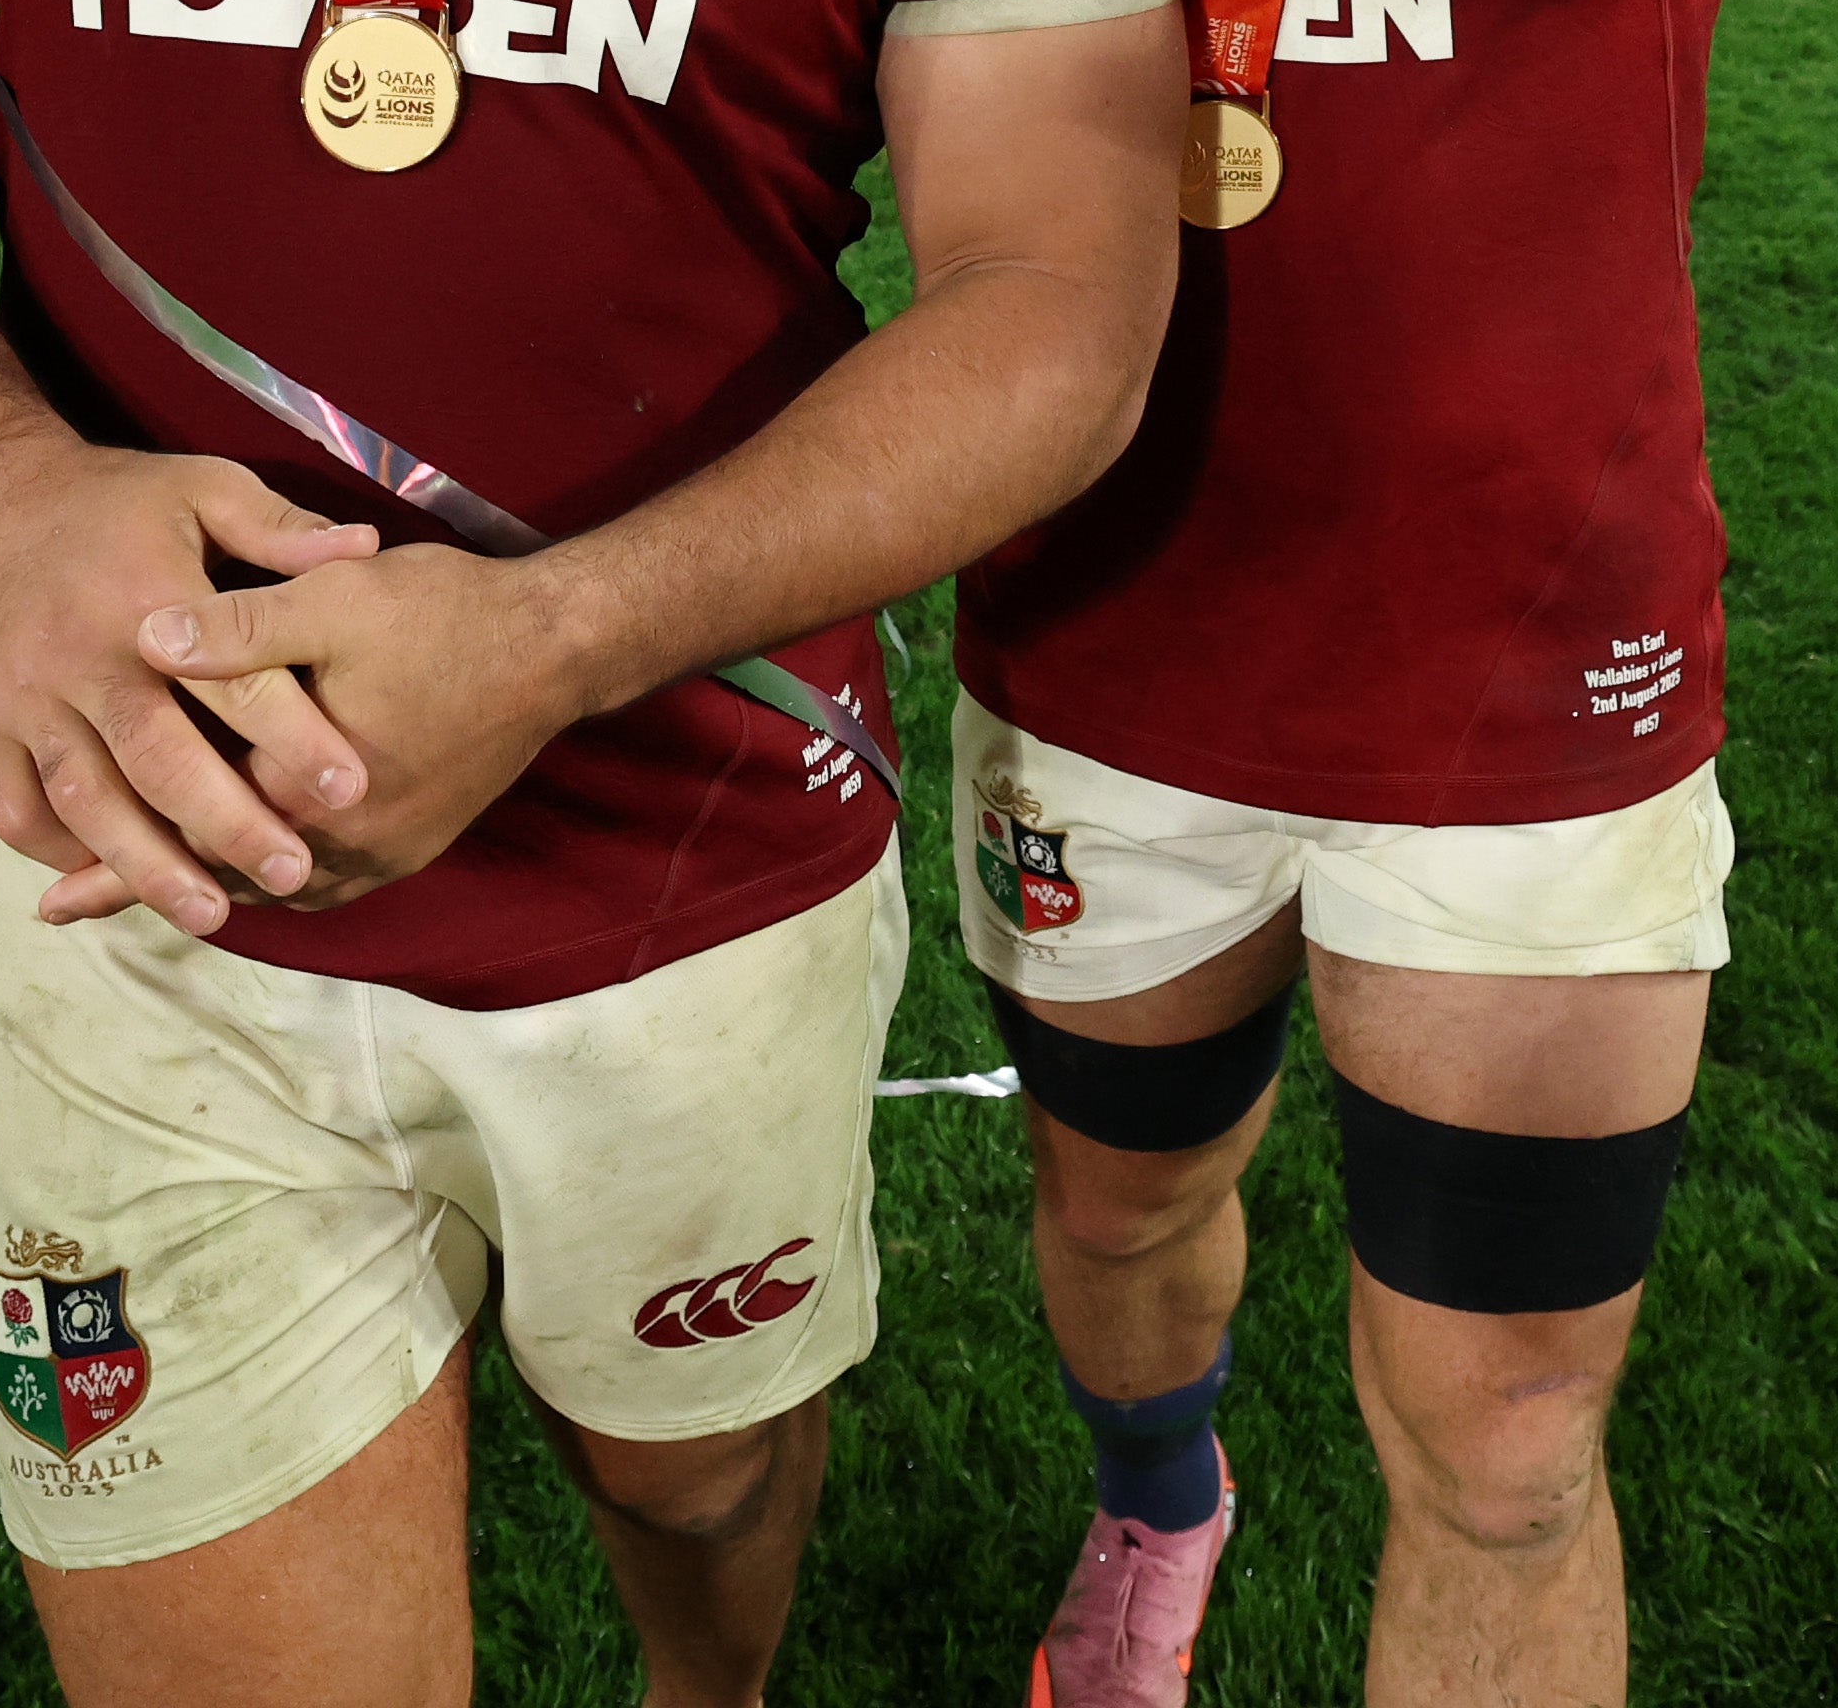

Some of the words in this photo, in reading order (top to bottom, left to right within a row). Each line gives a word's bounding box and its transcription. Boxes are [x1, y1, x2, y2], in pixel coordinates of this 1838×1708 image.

[1225, 21, 1246, 74] LIONS
[378, 70, 435, 87] QATAR
[391, 86, 436, 96] AIRWAYS
[376, 99, 435, 115] LIONS
[1215, 146, 1262, 160] QATAR
[1612, 639, 1640, 659] Ben
[1642, 630, 1665, 653] Earl
[1584, 664, 1649, 688] Wallabies
[1651, 660, 1658, 674] v
[1659, 647, 1683, 671] Lions
[1591, 693, 1618, 715] 2nd
[1621, 681, 1658, 709] August
[1659, 668, 1681, 693] 2025
[1633, 712, 1660, 737] #857
[806, 765, 828, 792] 2nd
[830, 749, 856, 779] Augus
[11, 1447, 163, 1483] AUSTRALIA
[42, 1483, 115, 1498] 2025
